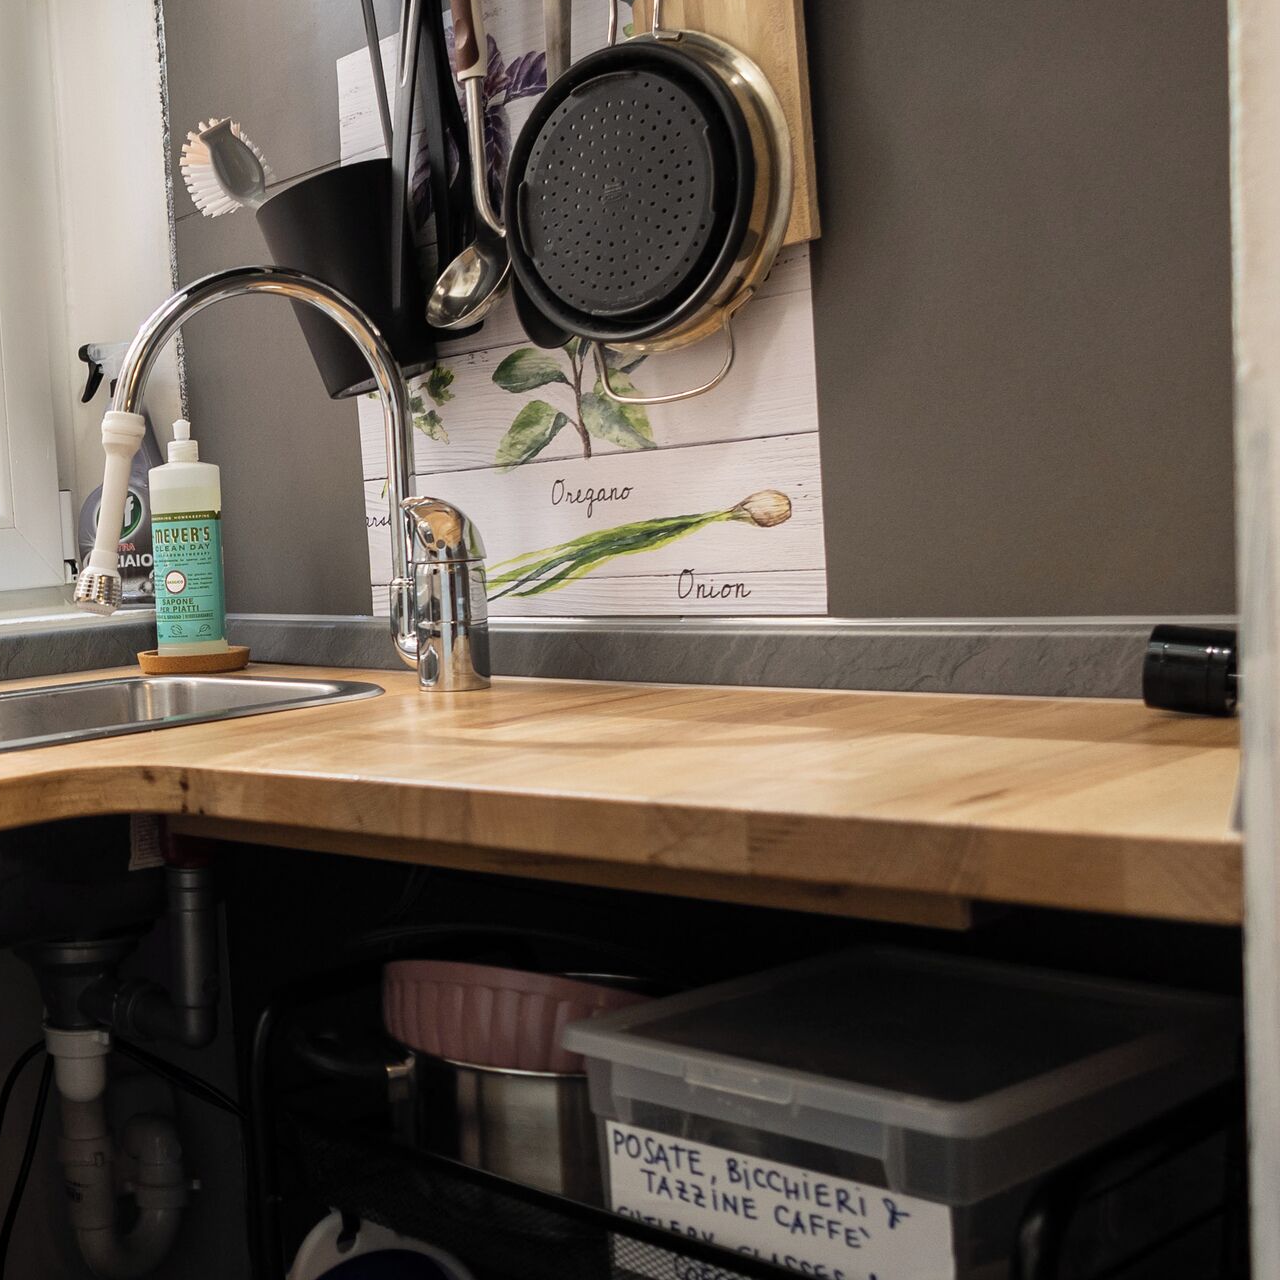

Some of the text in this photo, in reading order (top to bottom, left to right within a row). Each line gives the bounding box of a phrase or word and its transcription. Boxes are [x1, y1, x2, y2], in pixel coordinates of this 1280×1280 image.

[551, 478, 634, 518] Oregano
[677, 568, 752, 599] Onion
[162, 597, 194, 606] SAPONE
